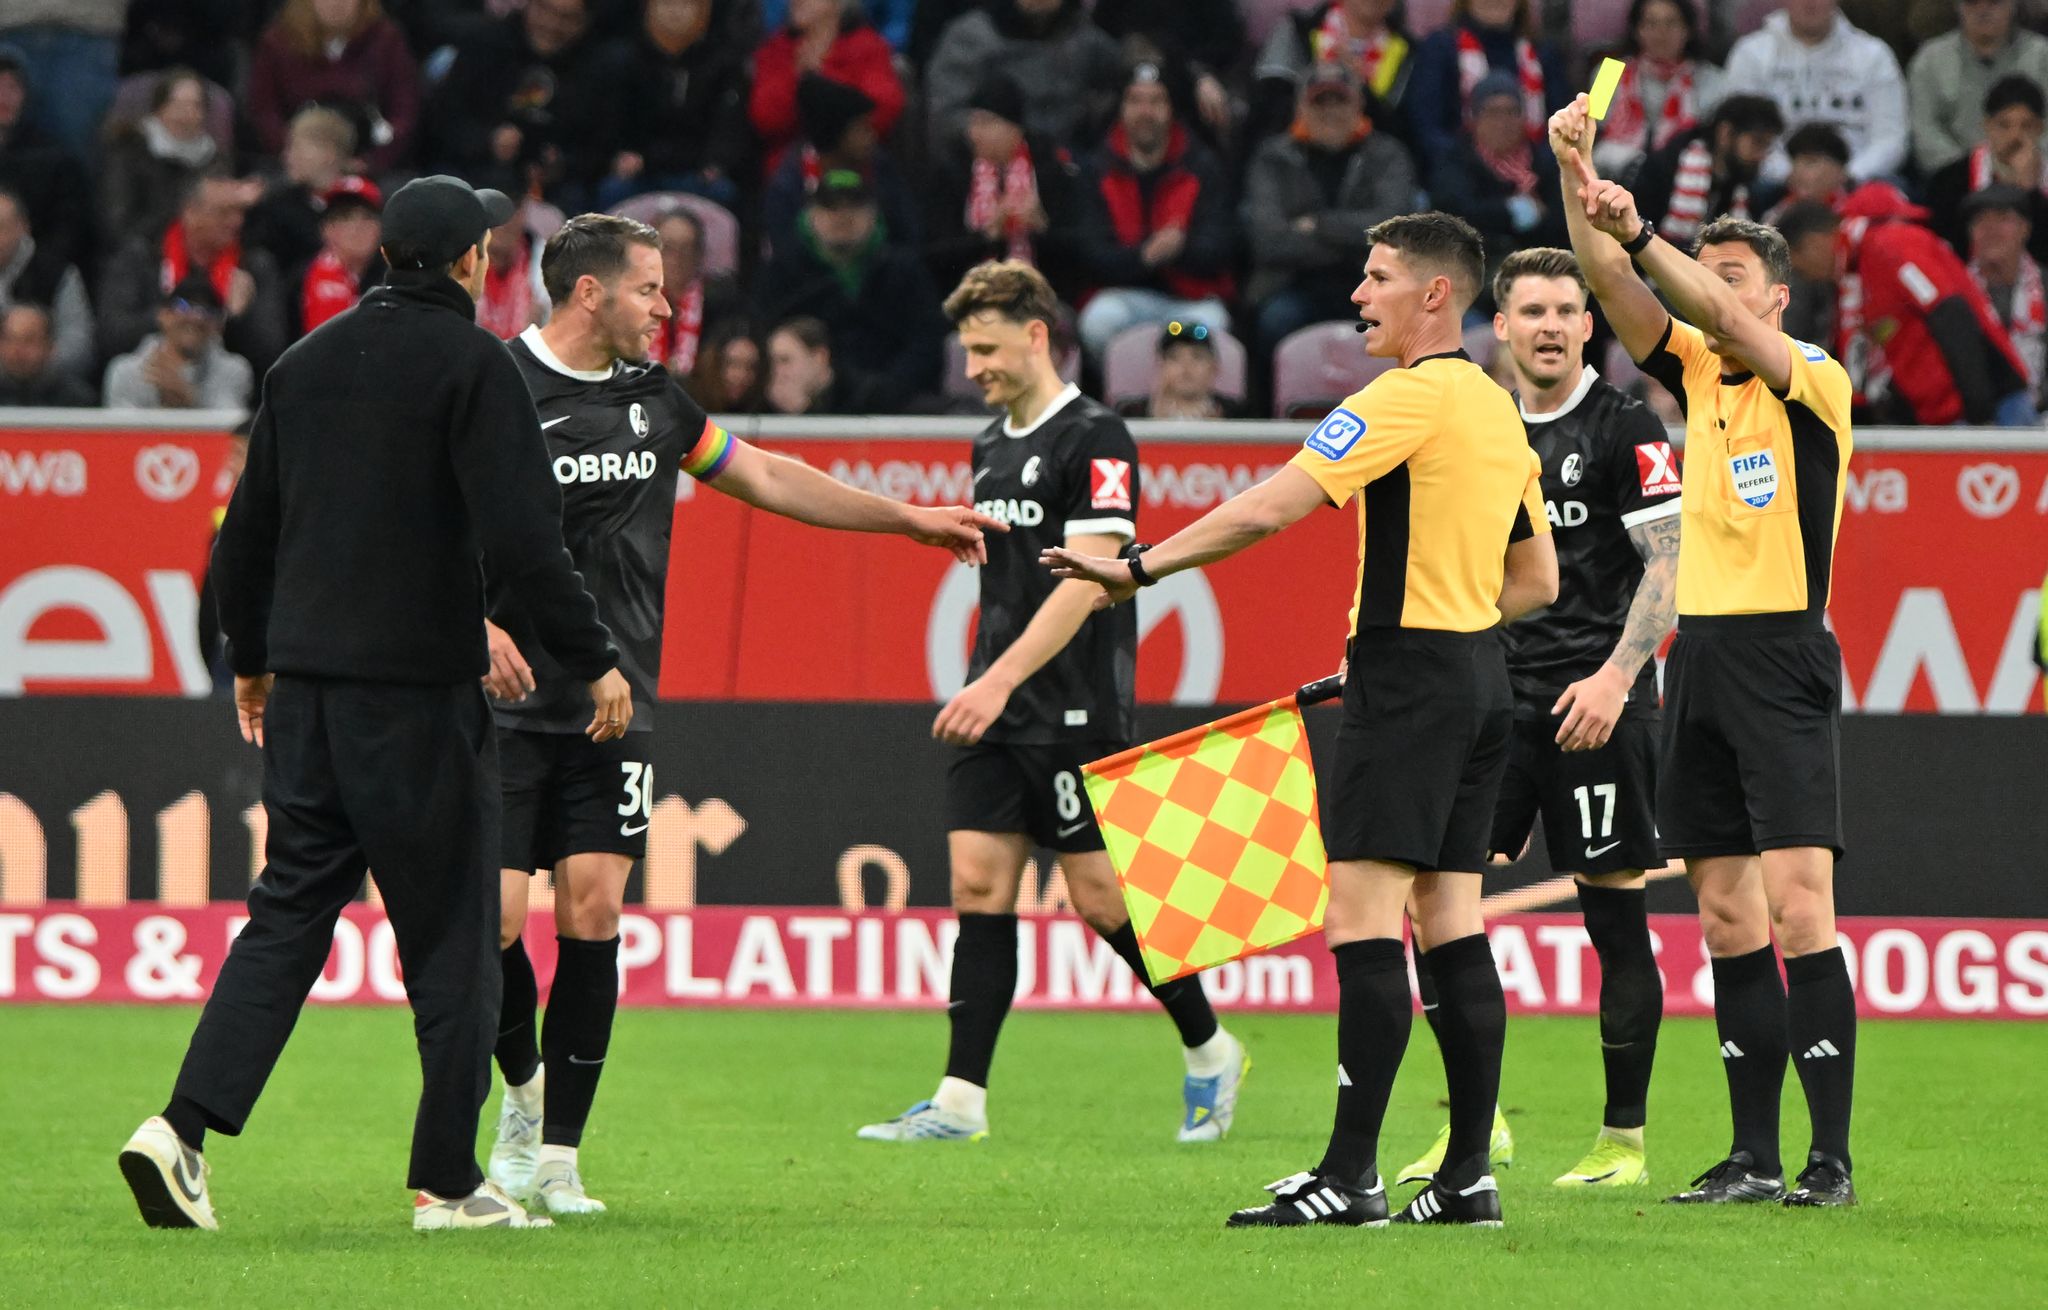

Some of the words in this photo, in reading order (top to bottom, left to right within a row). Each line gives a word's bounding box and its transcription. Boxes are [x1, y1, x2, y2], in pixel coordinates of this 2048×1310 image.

[1733, 453, 1771, 474] FIFA
[1738, 475, 1775, 490] REFEREE
[617, 761, 654, 819] 30
[1054, 770, 1081, 821] 8
[1574, 783, 1616, 838] 17
[124, 915, 204, 999] &
[1838, 929, 2048, 1014] OGS
